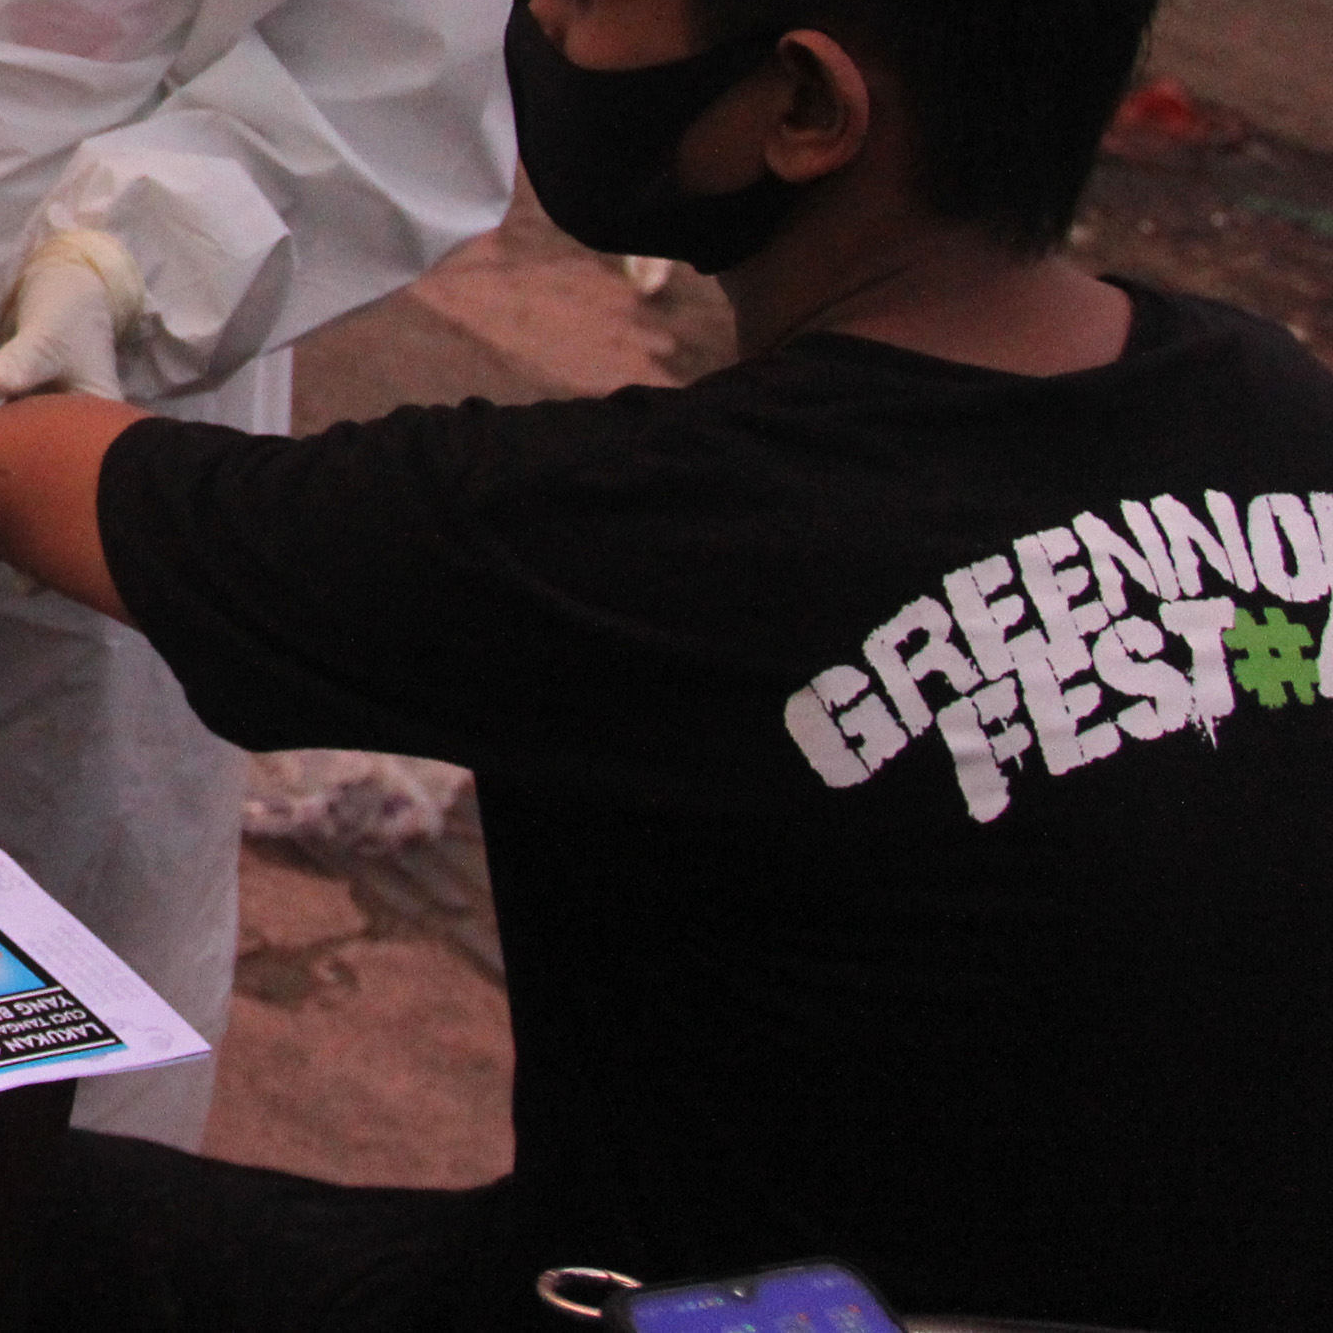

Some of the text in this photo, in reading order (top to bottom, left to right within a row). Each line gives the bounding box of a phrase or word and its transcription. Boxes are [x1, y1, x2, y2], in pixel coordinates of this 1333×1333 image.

[12, 994, 74, 1015] YANG
[46, 1008, 89, 1023] CUCI
[0, 1022, 105, 1052] LAKUKAN
